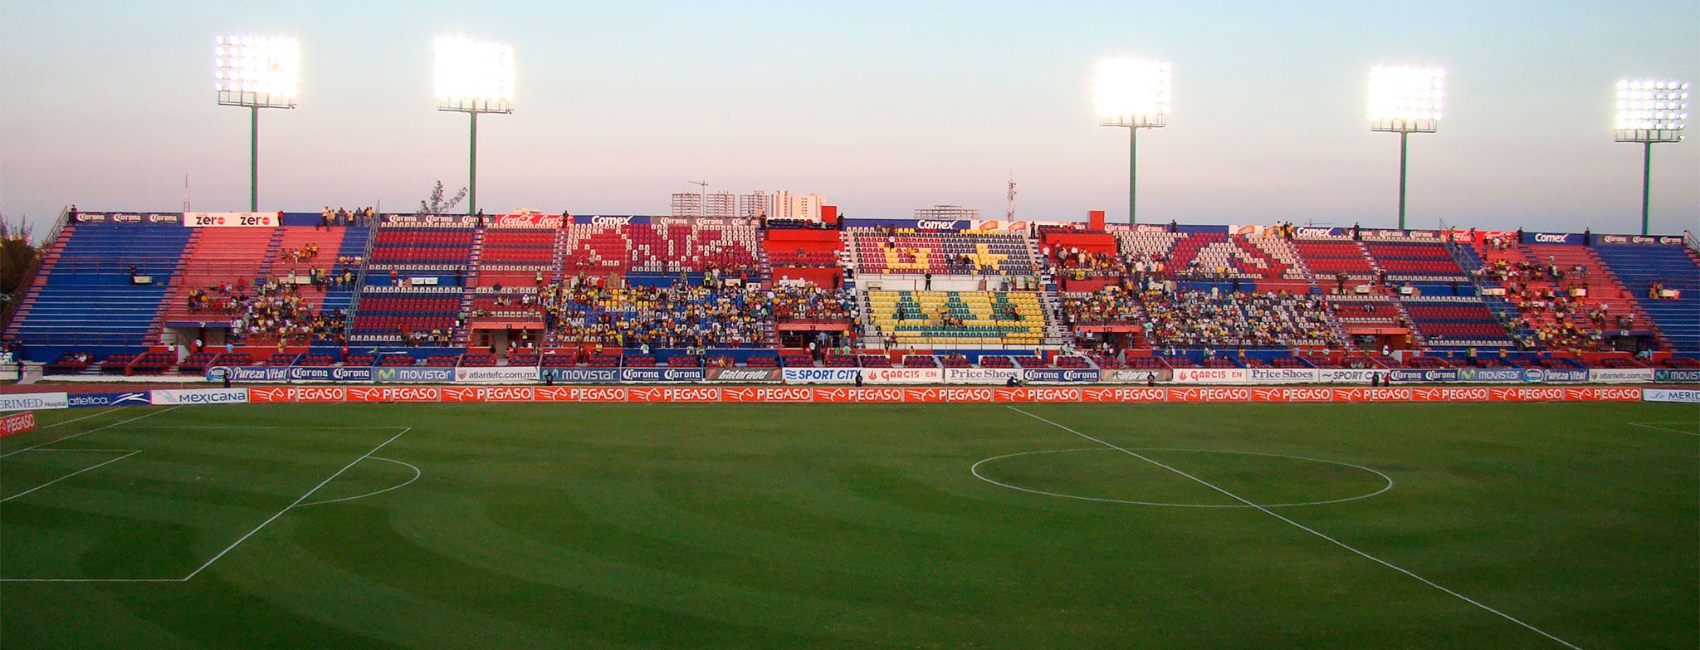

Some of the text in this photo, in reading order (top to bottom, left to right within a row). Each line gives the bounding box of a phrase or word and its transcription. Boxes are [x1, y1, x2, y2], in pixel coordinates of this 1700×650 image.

[77, 214, 177, 223] Corona Corona Corona
[389, 214, 417, 223] Corona
[426, 214, 453, 223] Corona
[592, 215, 634, 226] Comex
[660, 217, 688, 225] Corona
[696, 217, 723, 225] Corona
[917, 219, 958, 230] Comex
[1138, 224, 1163, 233] Corona
[1297, 227, 1334, 236] Comex
[1535, 233, 1569, 243] Comex
[233, 367, 288, 379] Pureza Vital
[291, 368, 370, 378] Corona Corona
[400, 370, 451, 379] movistar
[469, 370, 537, 379] atlantefc.com.mx
[562, 370, 617, 379] movistar
[623, 369, 701, 380] Corona Corona
[718, 369, 769, 379] Gatorade
[799, 369, 837, 380] SPORT
[951, 369, 1018, 378] Price Shoes
[1024, 369, 1097, 380] Corona Corona
[1252, 369, 1313, 379] Price Shoes
[1333, 371, 1363, 380] SPORT
[1425, 370, 1456, 380] Corona
[287, 388, 343, 400] PEGASO
[382, 388, 437, 400] PEGASO
[477, 388, 531, 400] PEGASO
[570, 388, 625, 400] PEGASO
[664, 388, 718, 400] PEGASO
[757, 388, 810, 400] PEGASO
[848, 388, 900, 400] PEGASO
[939, 388, 991, 400] PEGASO
[1028, 388, 1078, 400] PEGASO
[1115, 388, 1164, 400] PEGASO
[1200, 388, 1248, 400] PEGASO
[1283, 388, 1330, 400] PEGASO
[1363, 388, 1410, 400] PEGASO
[1441, 388, 1486, 400] PEGASO
[1518, 388, 1563, 400] PEGASO
[1593, 388, 1639, 400] PEGASO
[6, 414, 35, 433] PEGASO
